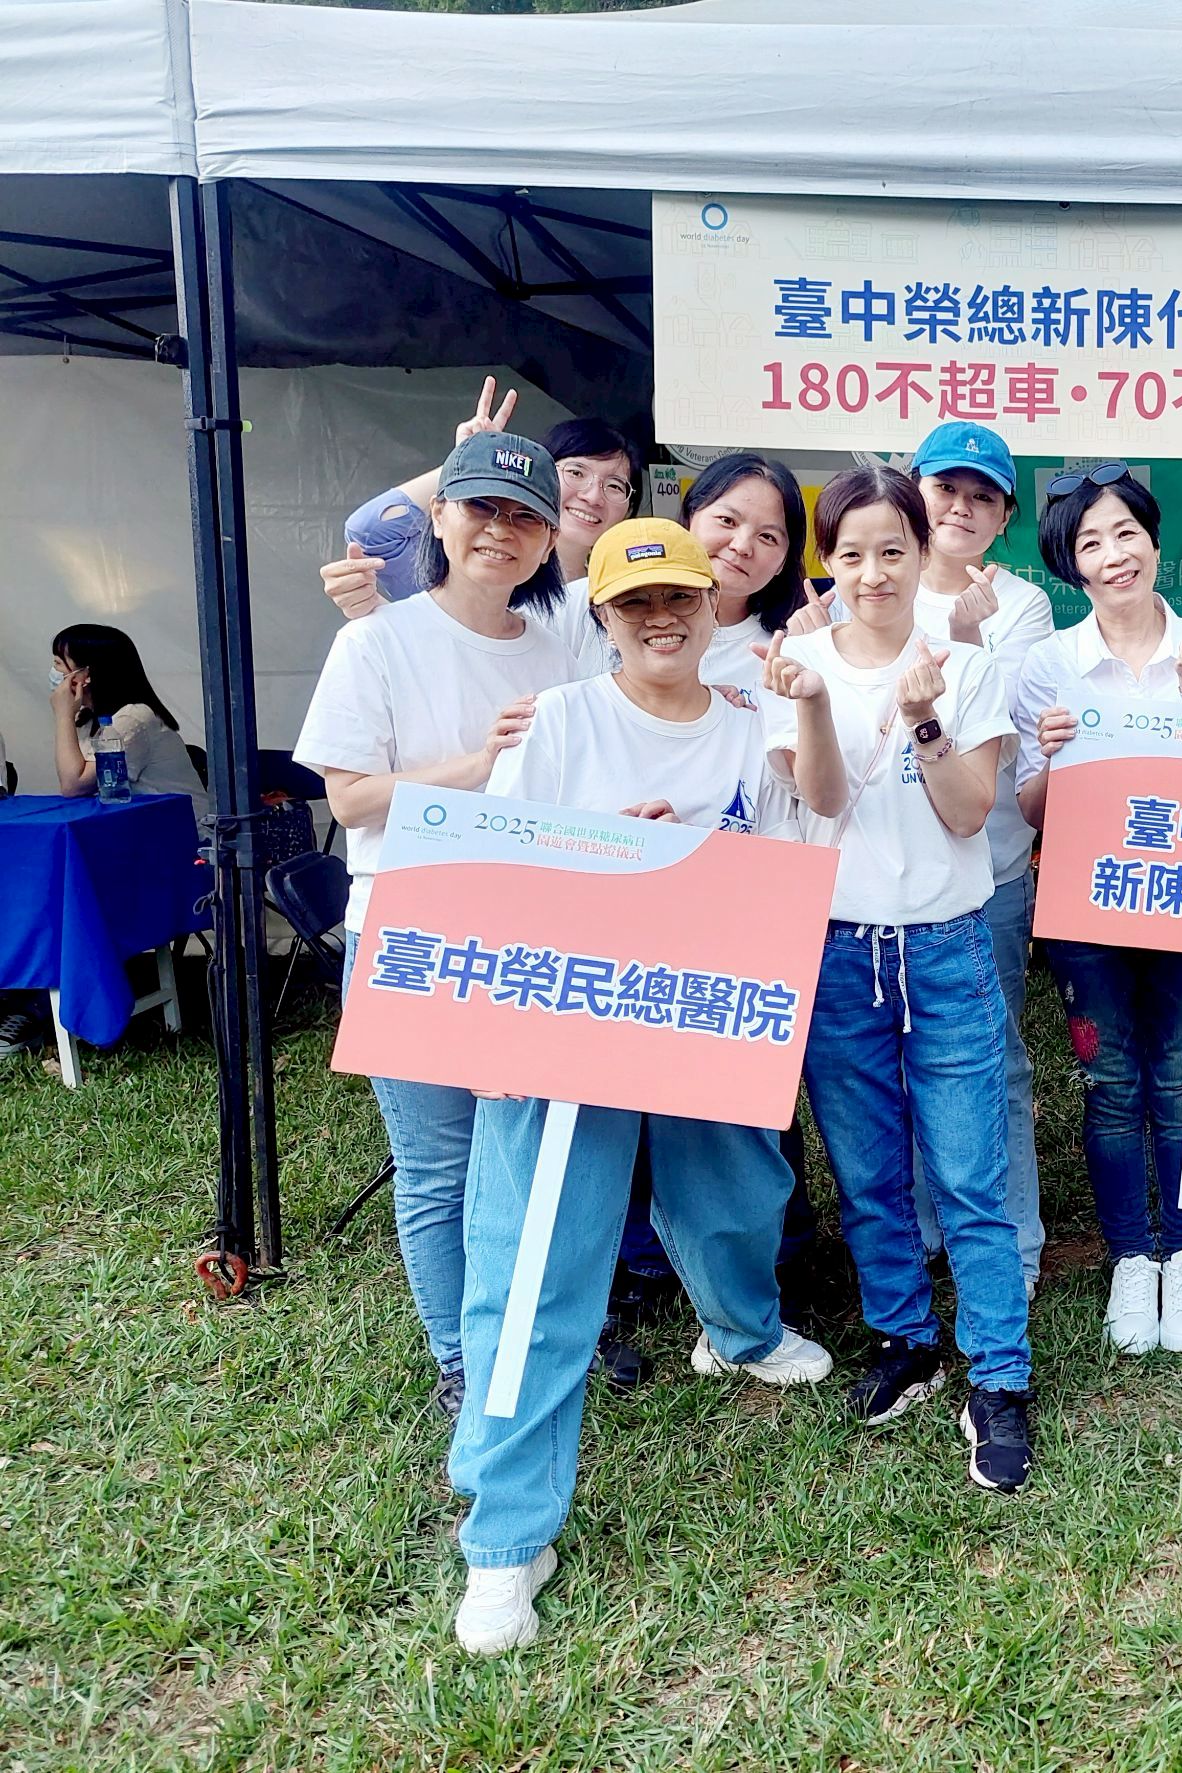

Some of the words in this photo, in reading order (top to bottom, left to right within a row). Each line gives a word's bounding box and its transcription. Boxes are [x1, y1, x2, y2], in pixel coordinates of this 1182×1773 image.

[680, 232, 701, 240] world
[703, 233, 735, 241] diabetes
[736, 235, 750, 244] day
[496, 450, 523, 470] NIKE
[657, 482, 680, 496] 400
[1122, 713, 1174, 739] 2025
[401, 825, 420, 833] world
[421, 828, 449, 837] diabetes
[450, 831, 462, 840] day
[474, 812, 538, 844] 2025
[372, 929, 797, 1043] 臺中榮民總醫院
